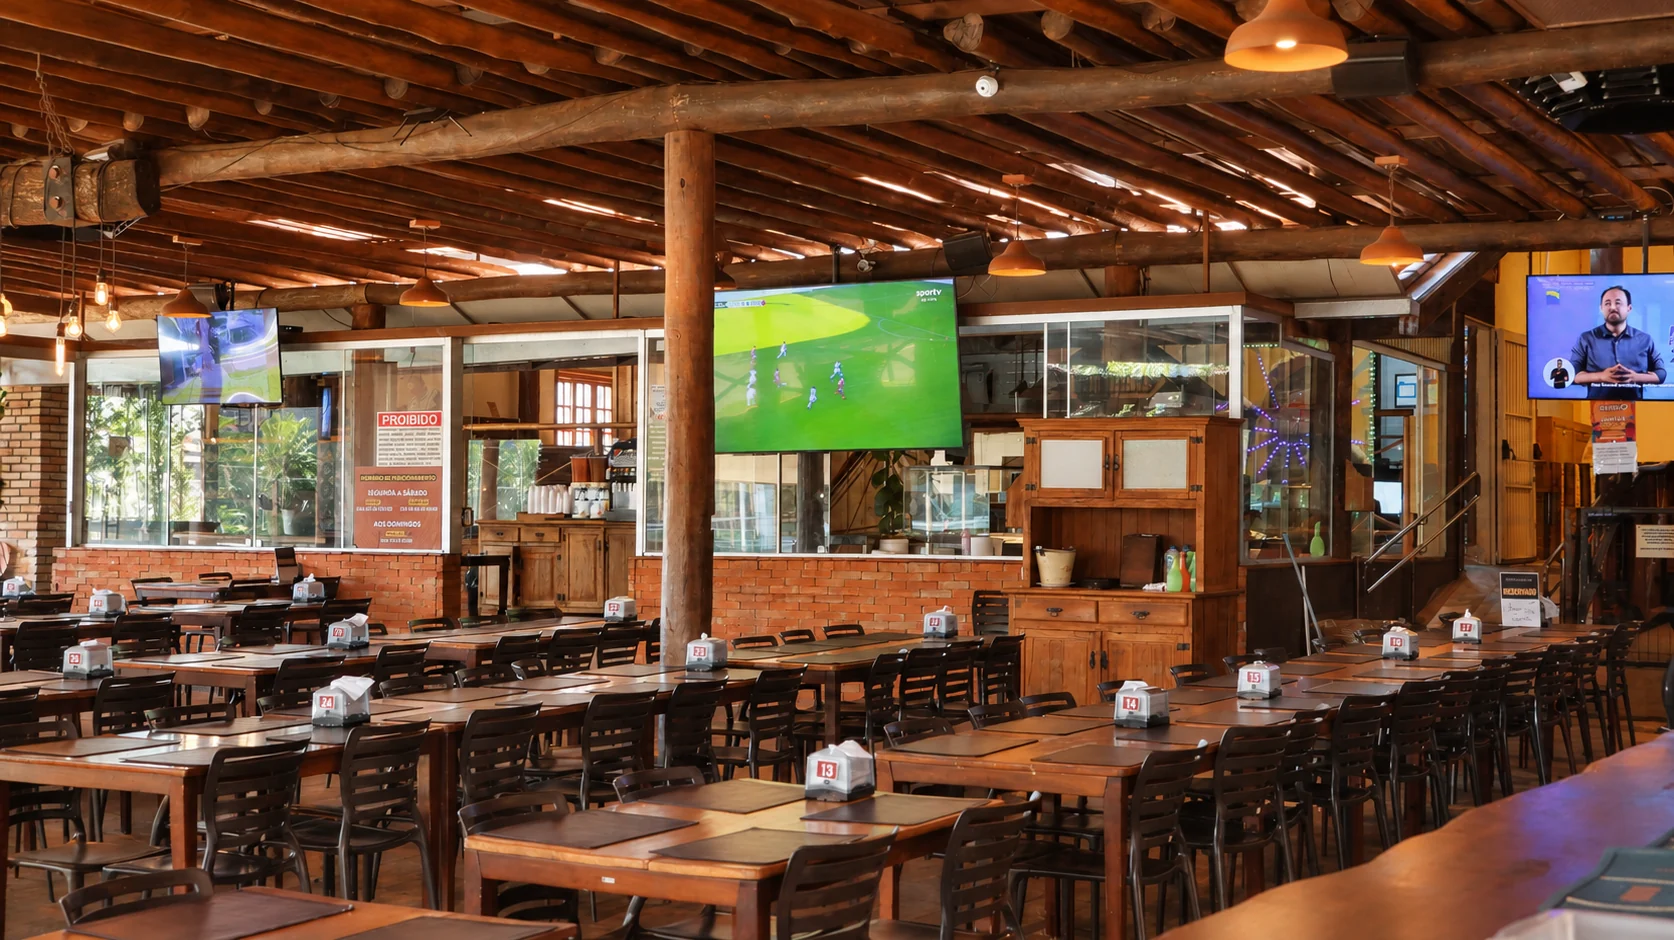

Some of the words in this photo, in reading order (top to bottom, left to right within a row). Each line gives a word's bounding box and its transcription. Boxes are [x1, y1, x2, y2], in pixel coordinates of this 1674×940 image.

[916, 288, 942, 297] sportv
[382, 414, 438, 425] PROIBIDO
[1249, 672, 1260, 683] 15
[322, 696, 333, 708] 24
[1126, 698, 1137, 709] 14
[821, 763, 834, 777] 13
